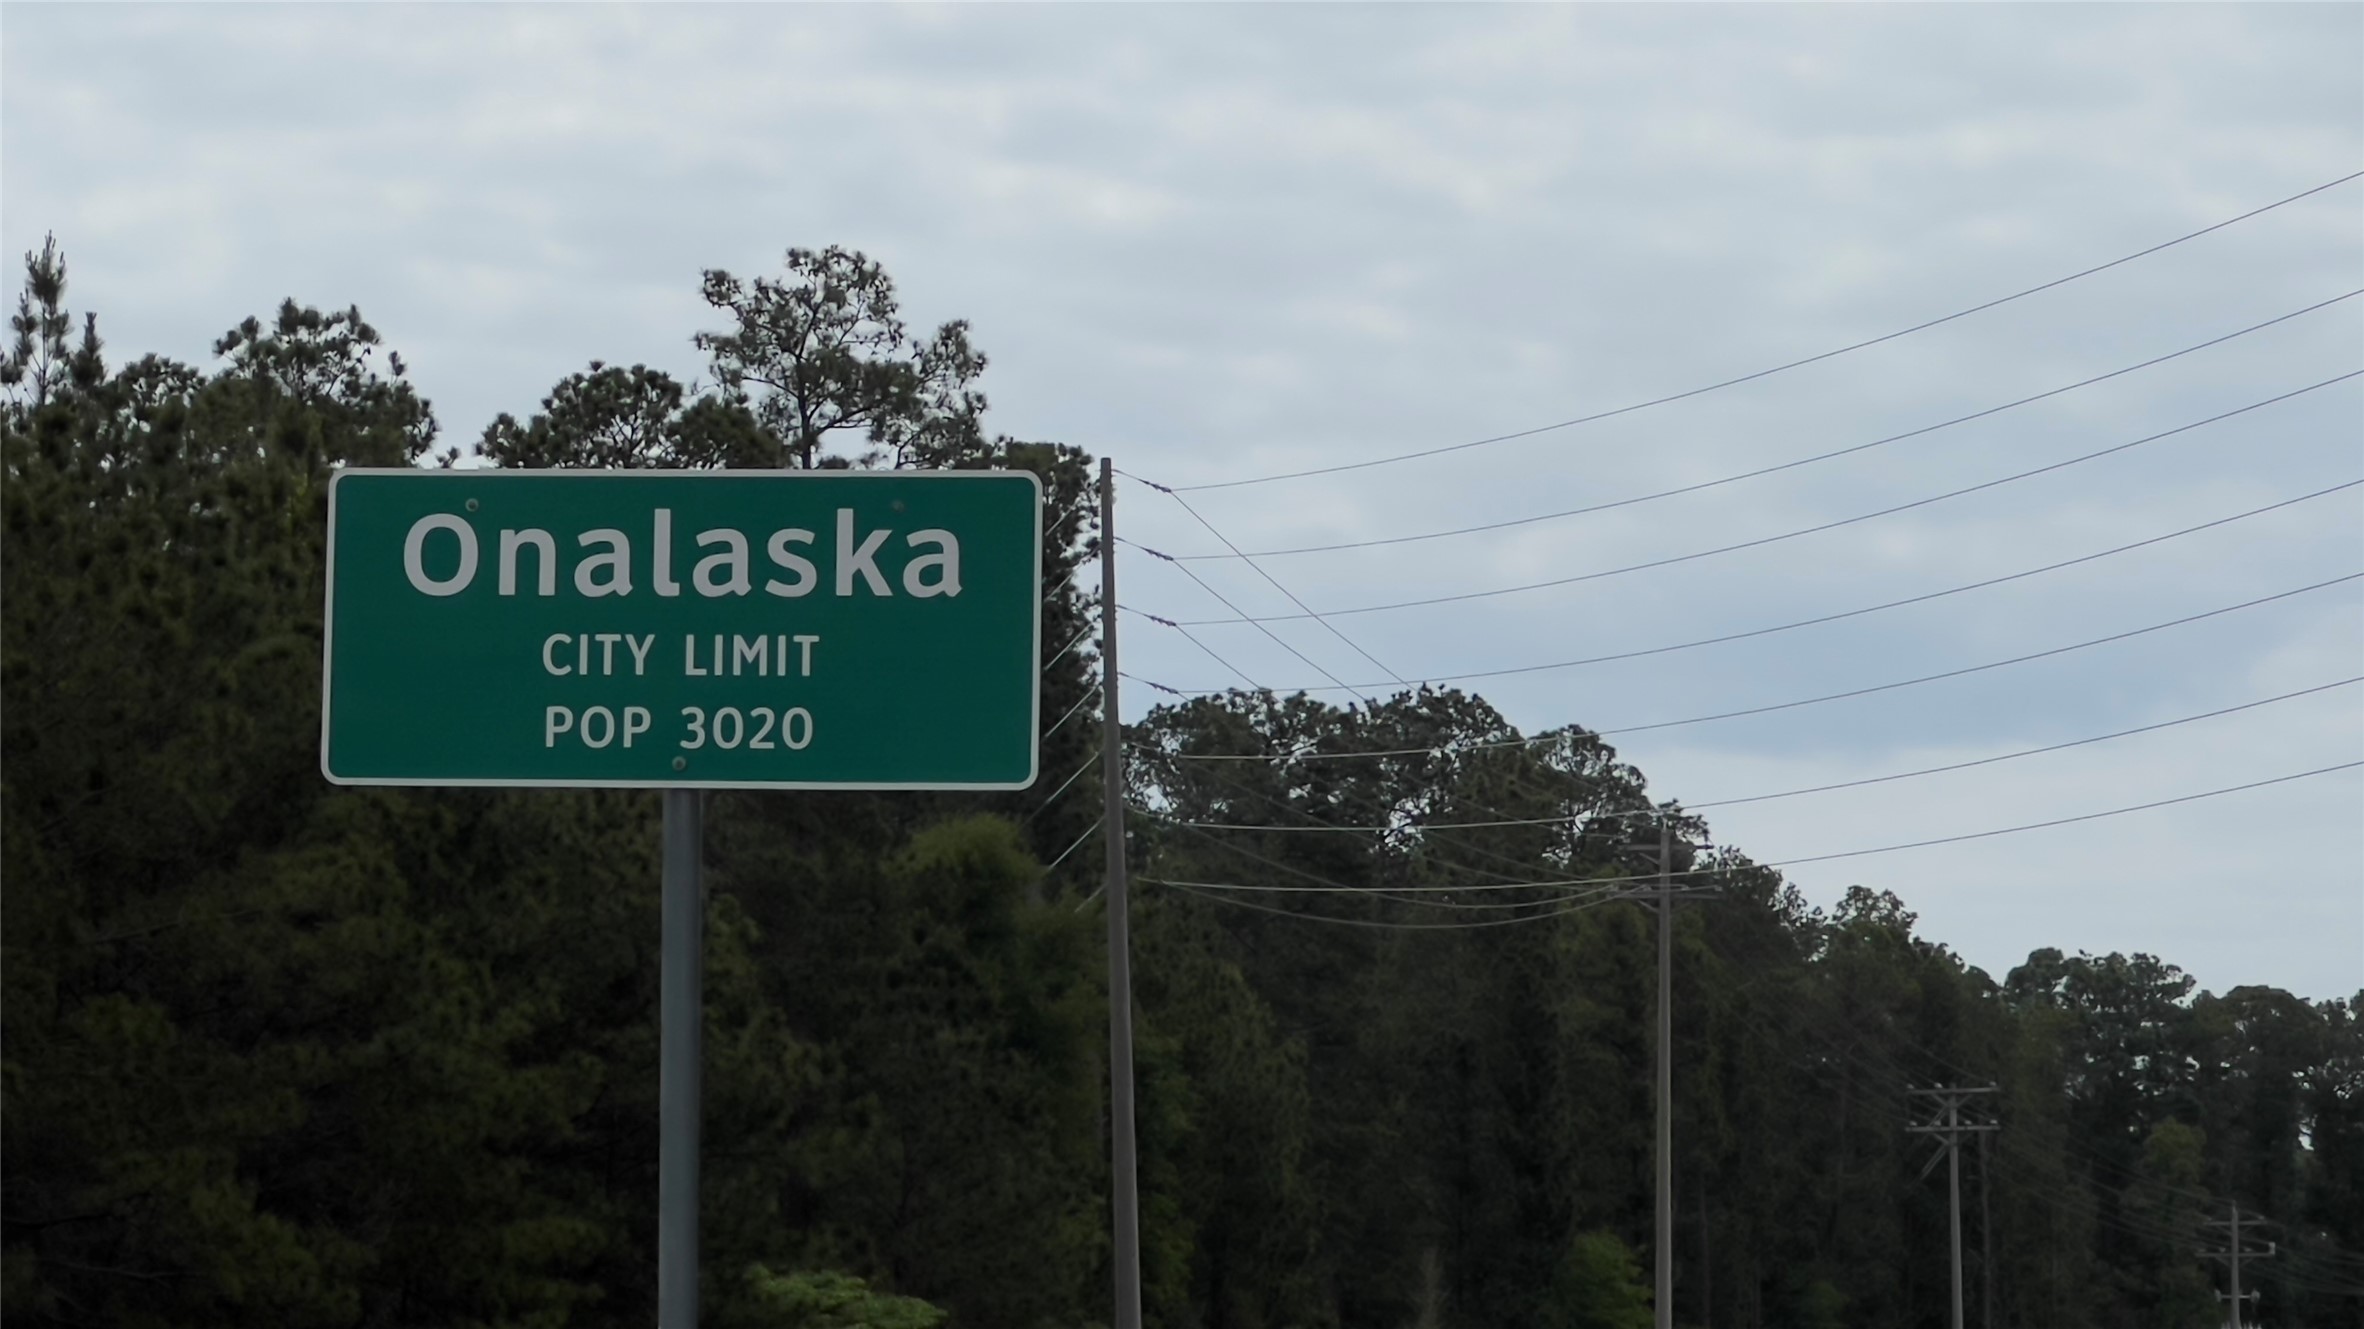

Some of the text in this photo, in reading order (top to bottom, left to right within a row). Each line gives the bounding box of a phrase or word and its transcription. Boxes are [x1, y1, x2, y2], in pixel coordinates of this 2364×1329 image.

[404, 508, 962, 598] Onalaska
[543, 633, 819, 676] CITY LIMIT
[546, 706, 813, 750] POP 3020
